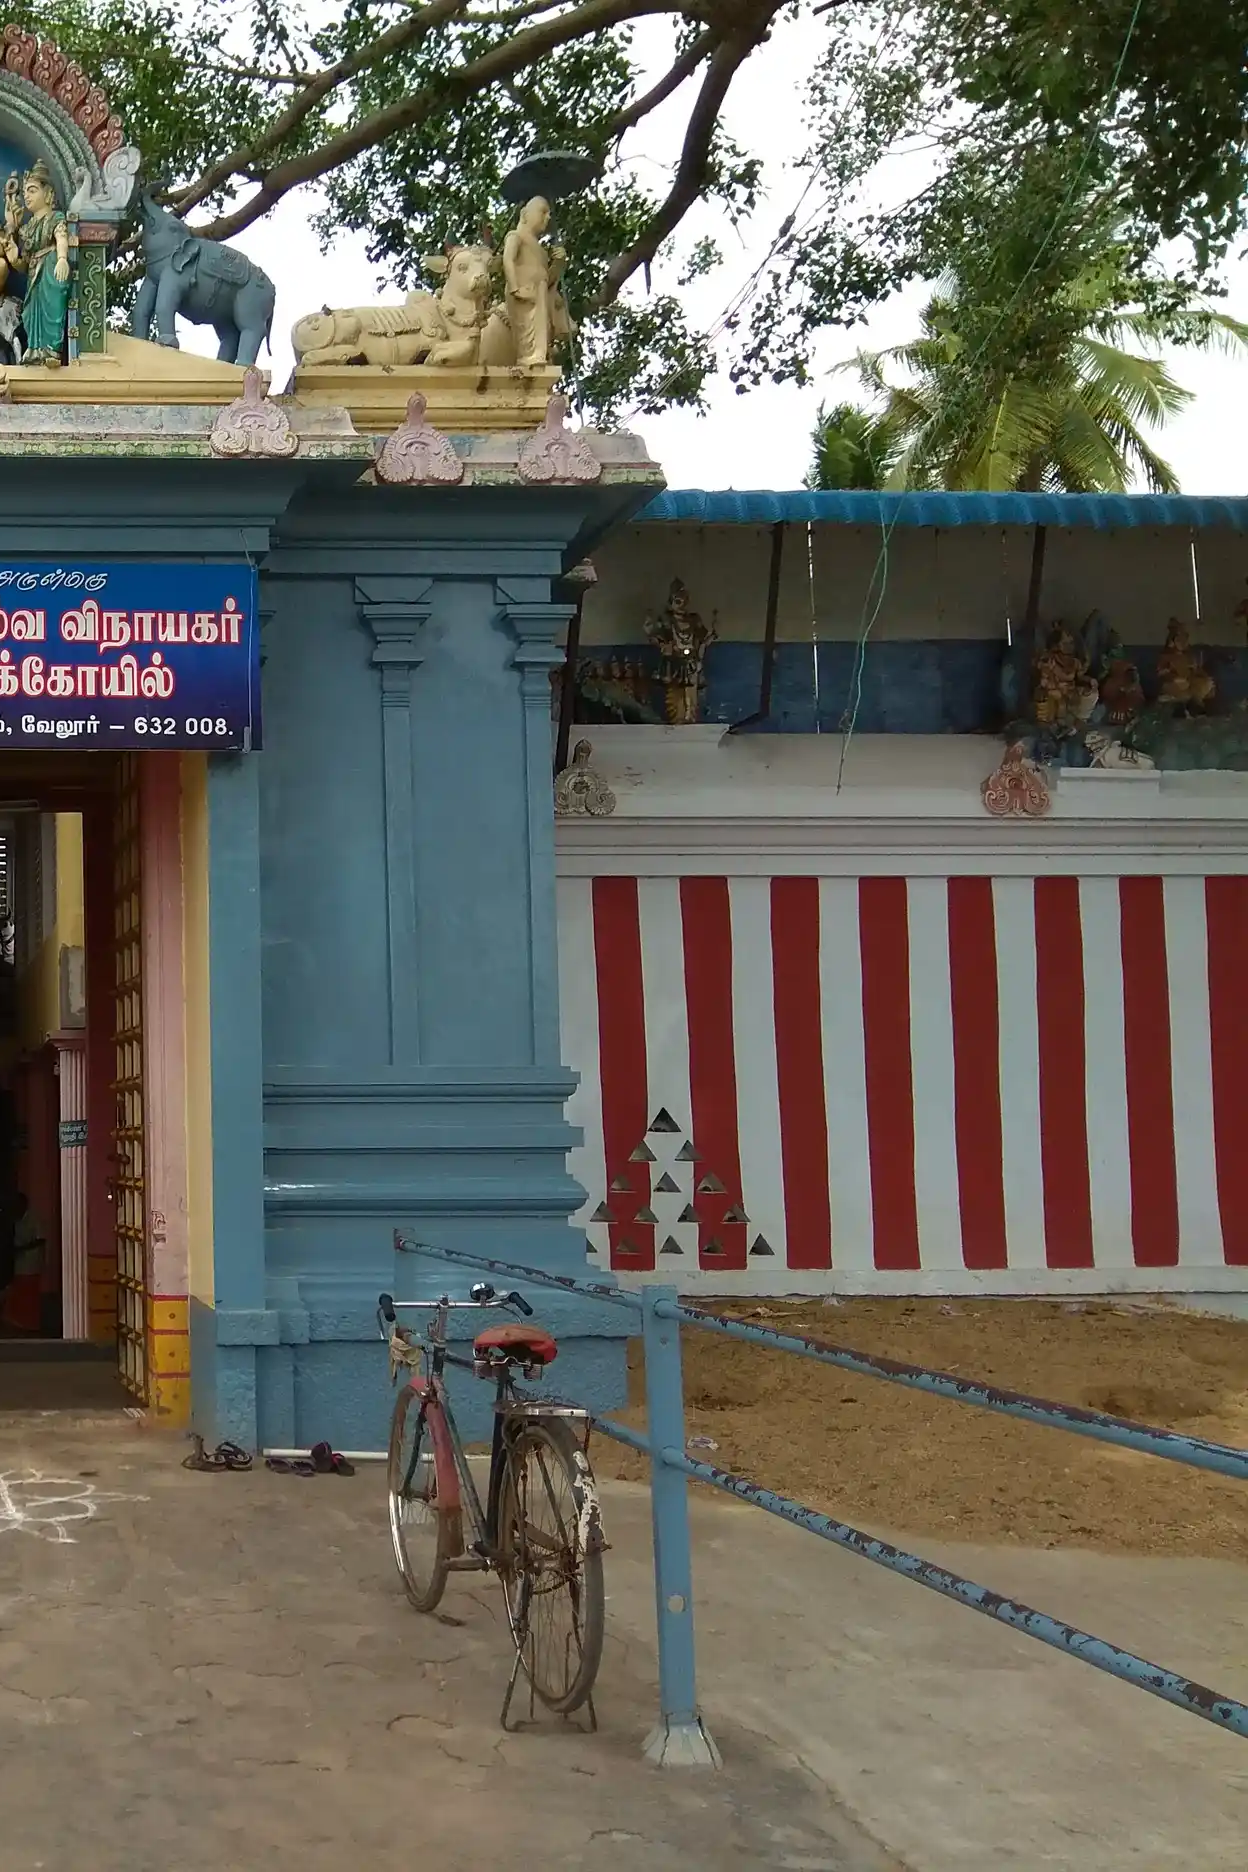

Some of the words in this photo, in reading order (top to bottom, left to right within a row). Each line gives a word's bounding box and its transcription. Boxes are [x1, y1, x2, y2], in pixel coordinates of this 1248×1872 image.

[59, 596, 244, 654] விநாயகர்
[21, 714, 101, 739] வேலூர்
[133, 716, 177, 736] 632
[184, 716, 235, 736] 008.
